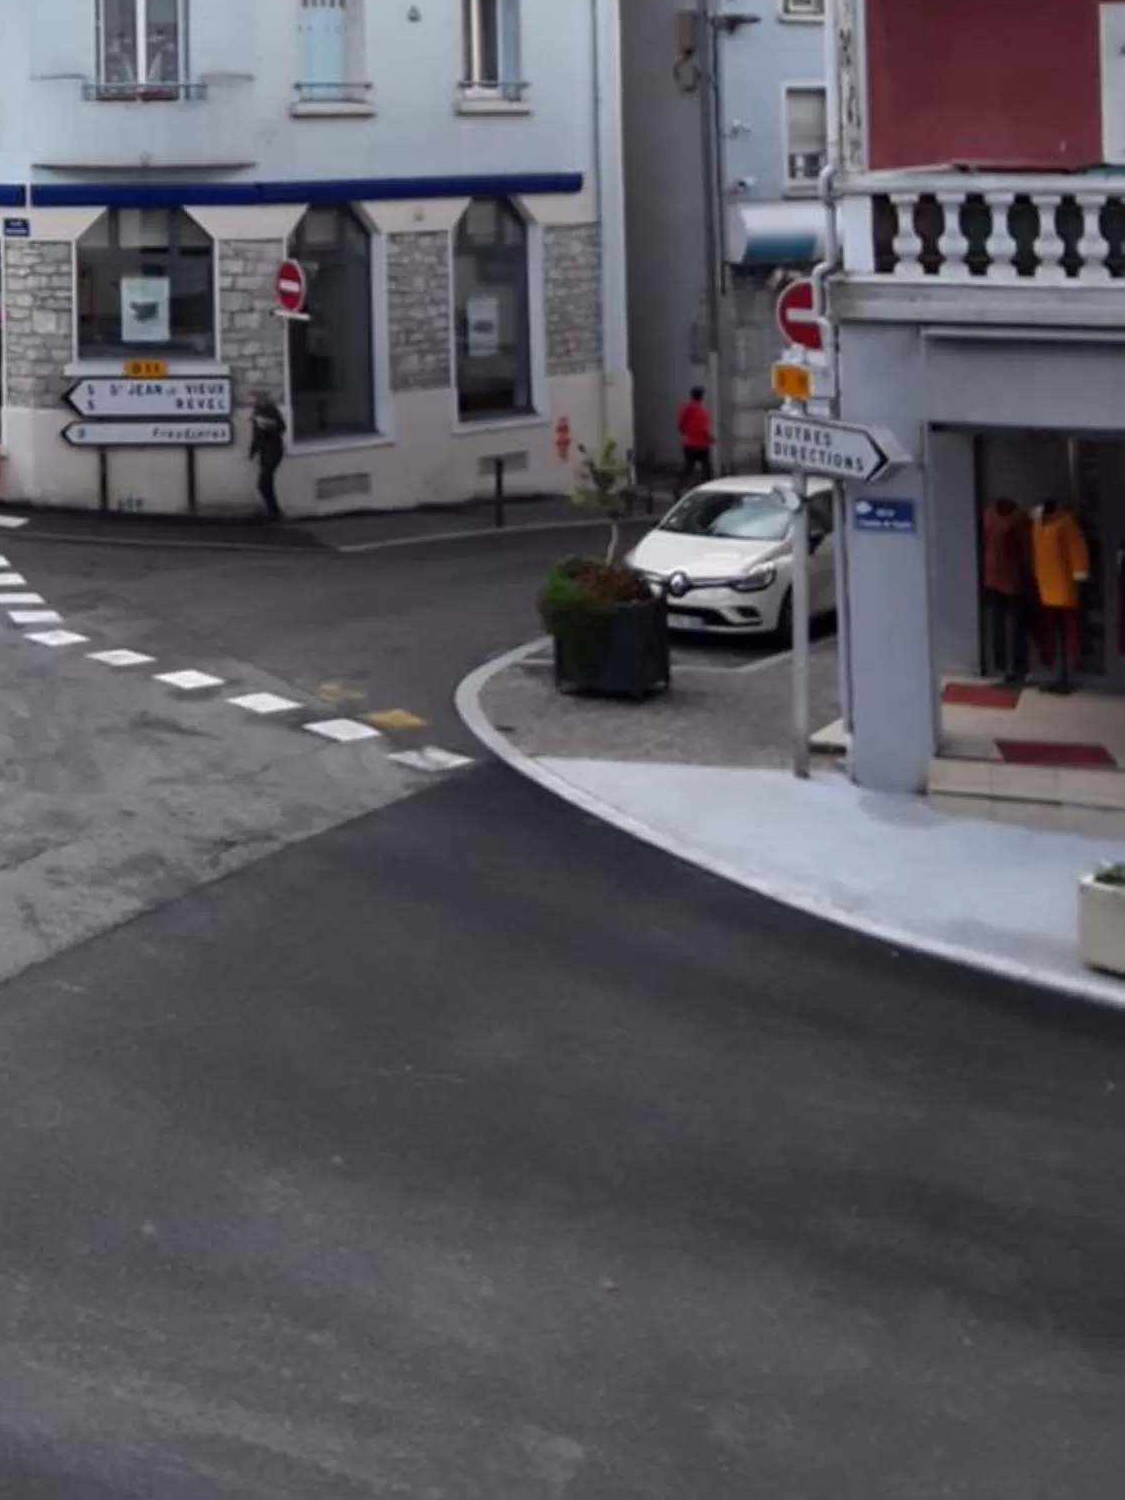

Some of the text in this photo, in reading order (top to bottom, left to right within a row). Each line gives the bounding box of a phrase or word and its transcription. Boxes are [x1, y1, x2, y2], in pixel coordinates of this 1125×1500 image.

[128, 383, 163, 396] JEAN
[185, 383, 225, 395] VIEUX
[176, 399, 226, 411] REVEL
[775, 423, 832, 447] AUTRES
[774, 441, 864, 473] DIRECTIONS
